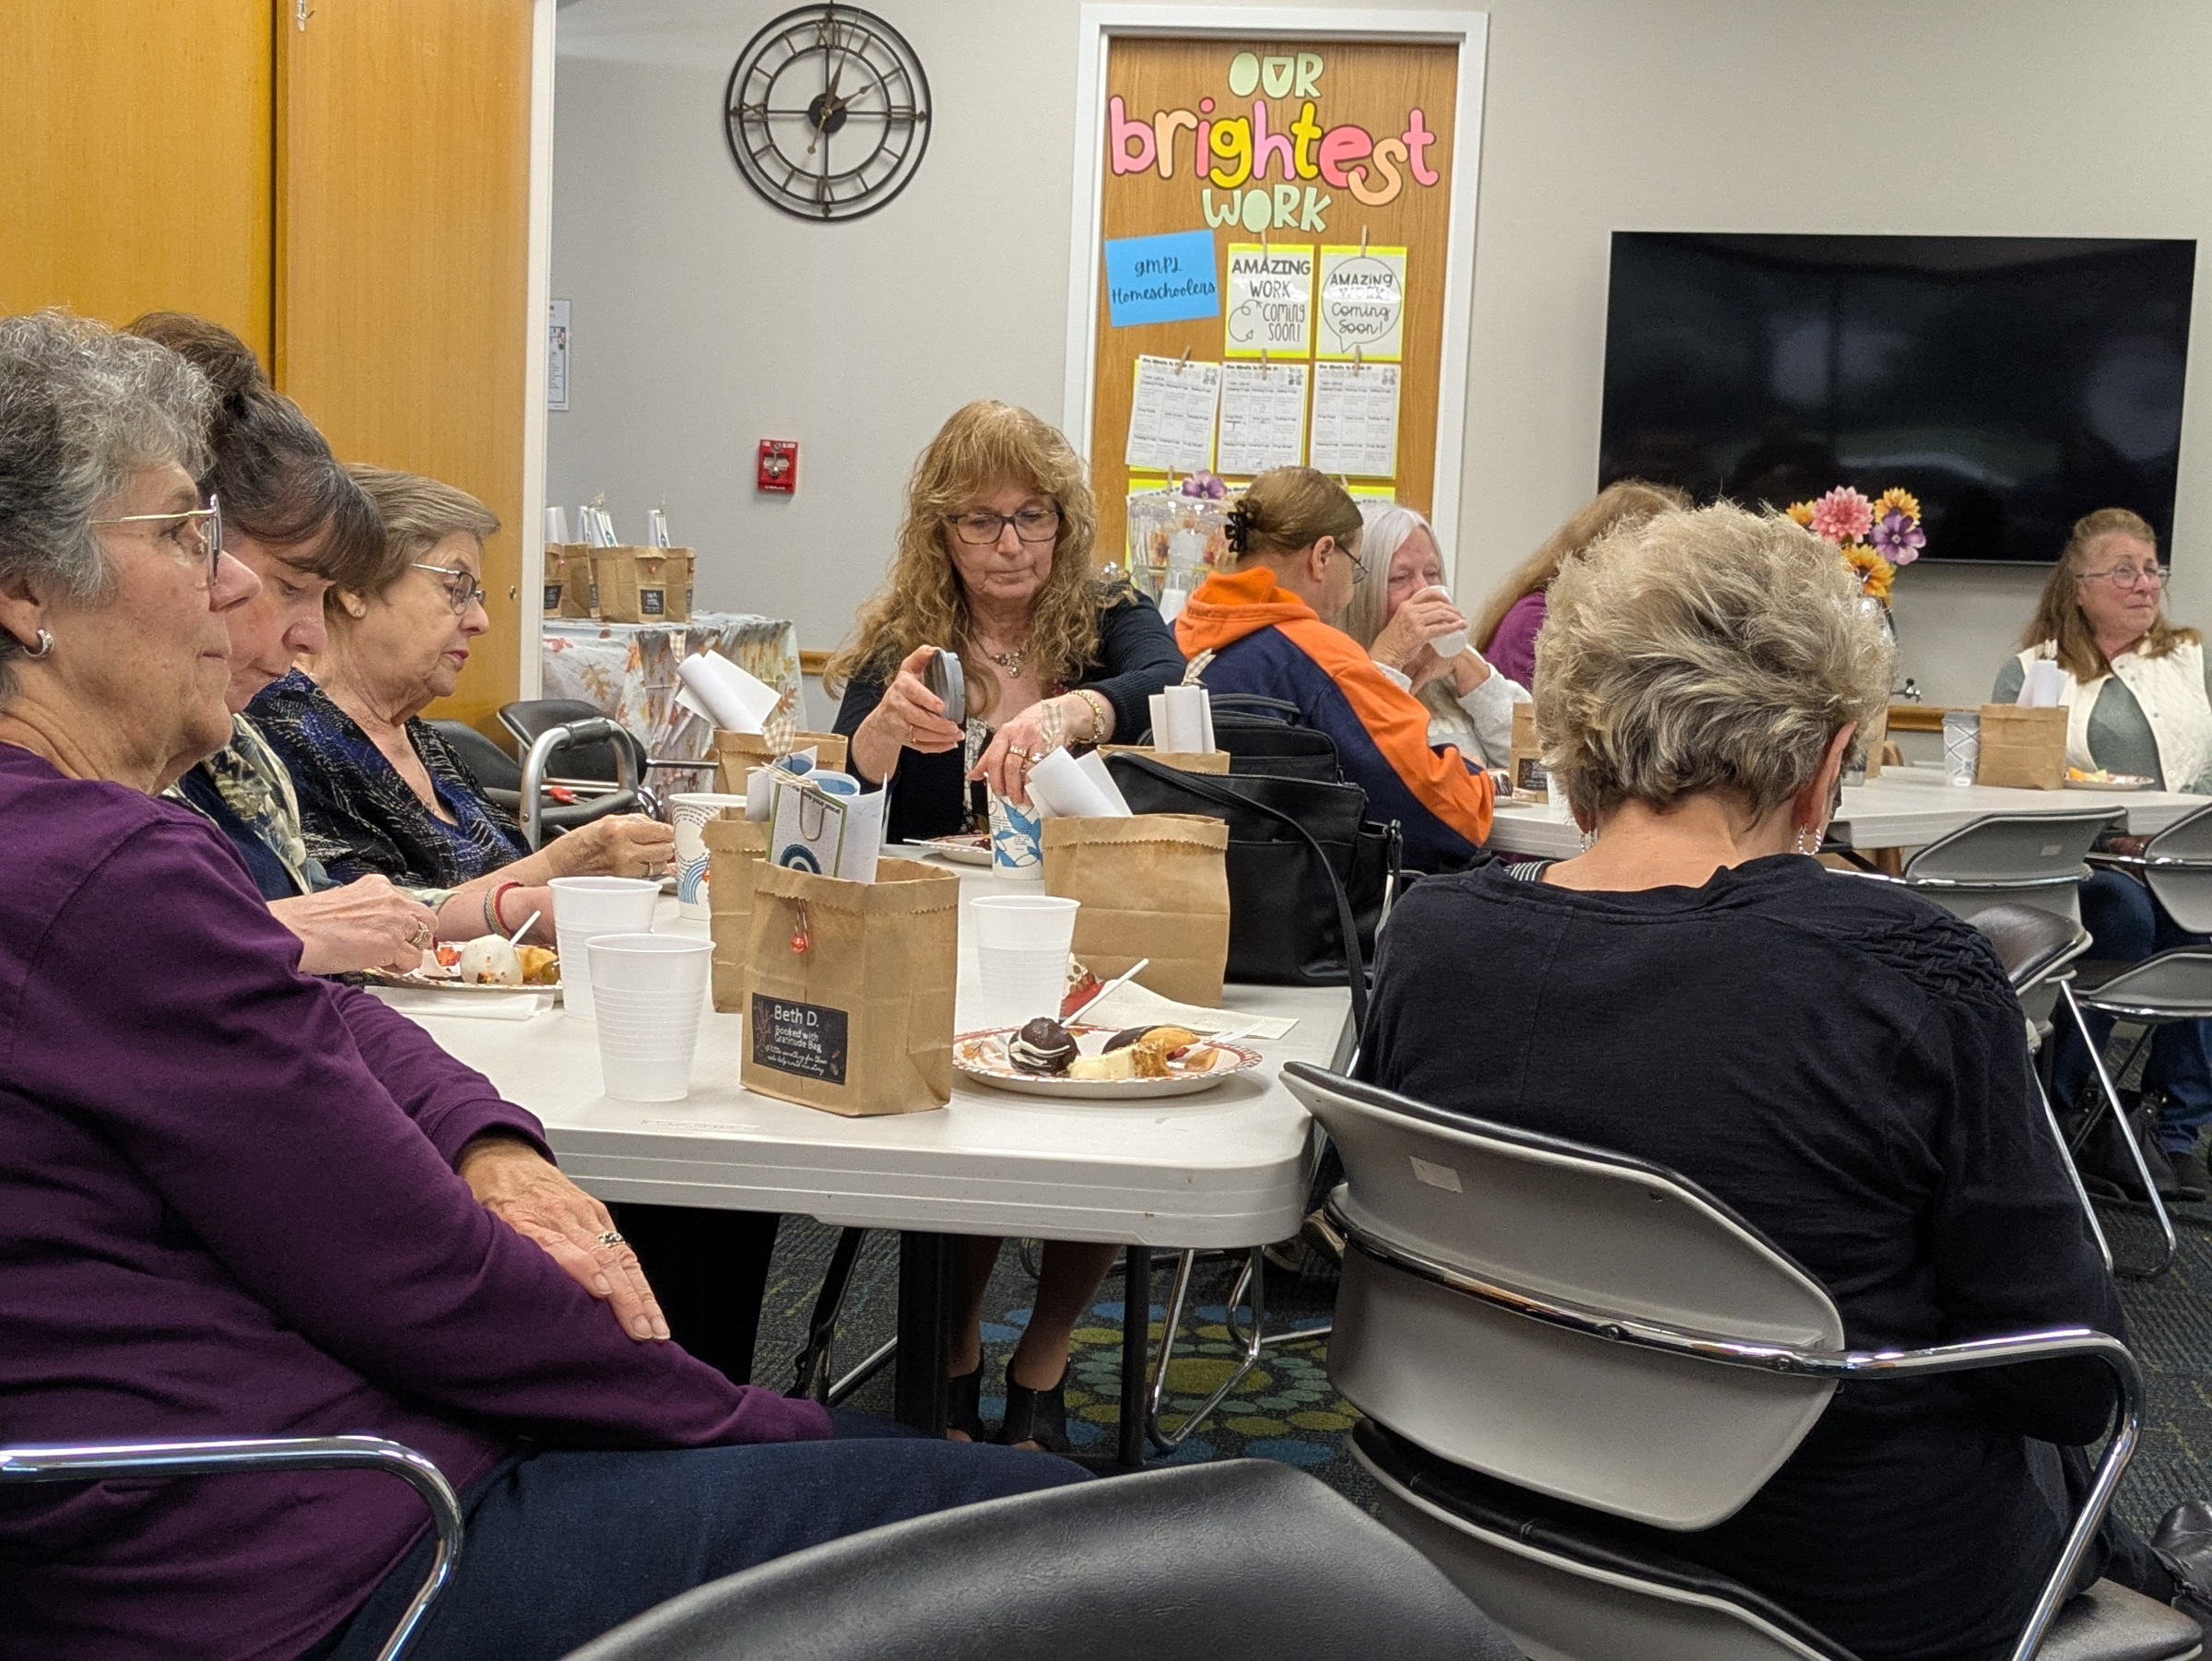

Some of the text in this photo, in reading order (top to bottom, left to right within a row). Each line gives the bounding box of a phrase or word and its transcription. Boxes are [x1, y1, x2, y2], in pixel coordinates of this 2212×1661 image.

[1228, 52, 1325, 99] OUR
[1109, 94, 1440, 206] brightest
[1202, 183, 1333, 233] WORK
[1231, 258, 1311, 276] AMAZING
[1112, 278, 1216, 305] Homeschoolers
[1250, 279, 1291, 300] WORK
[1331, 302, 1391, 321] Coming
[774, 1004, 819, 1028] Beth D.
[774, 1033, 822, 1054] Gratitude Bag
[775, 1024, 819, 1043] Booked with
